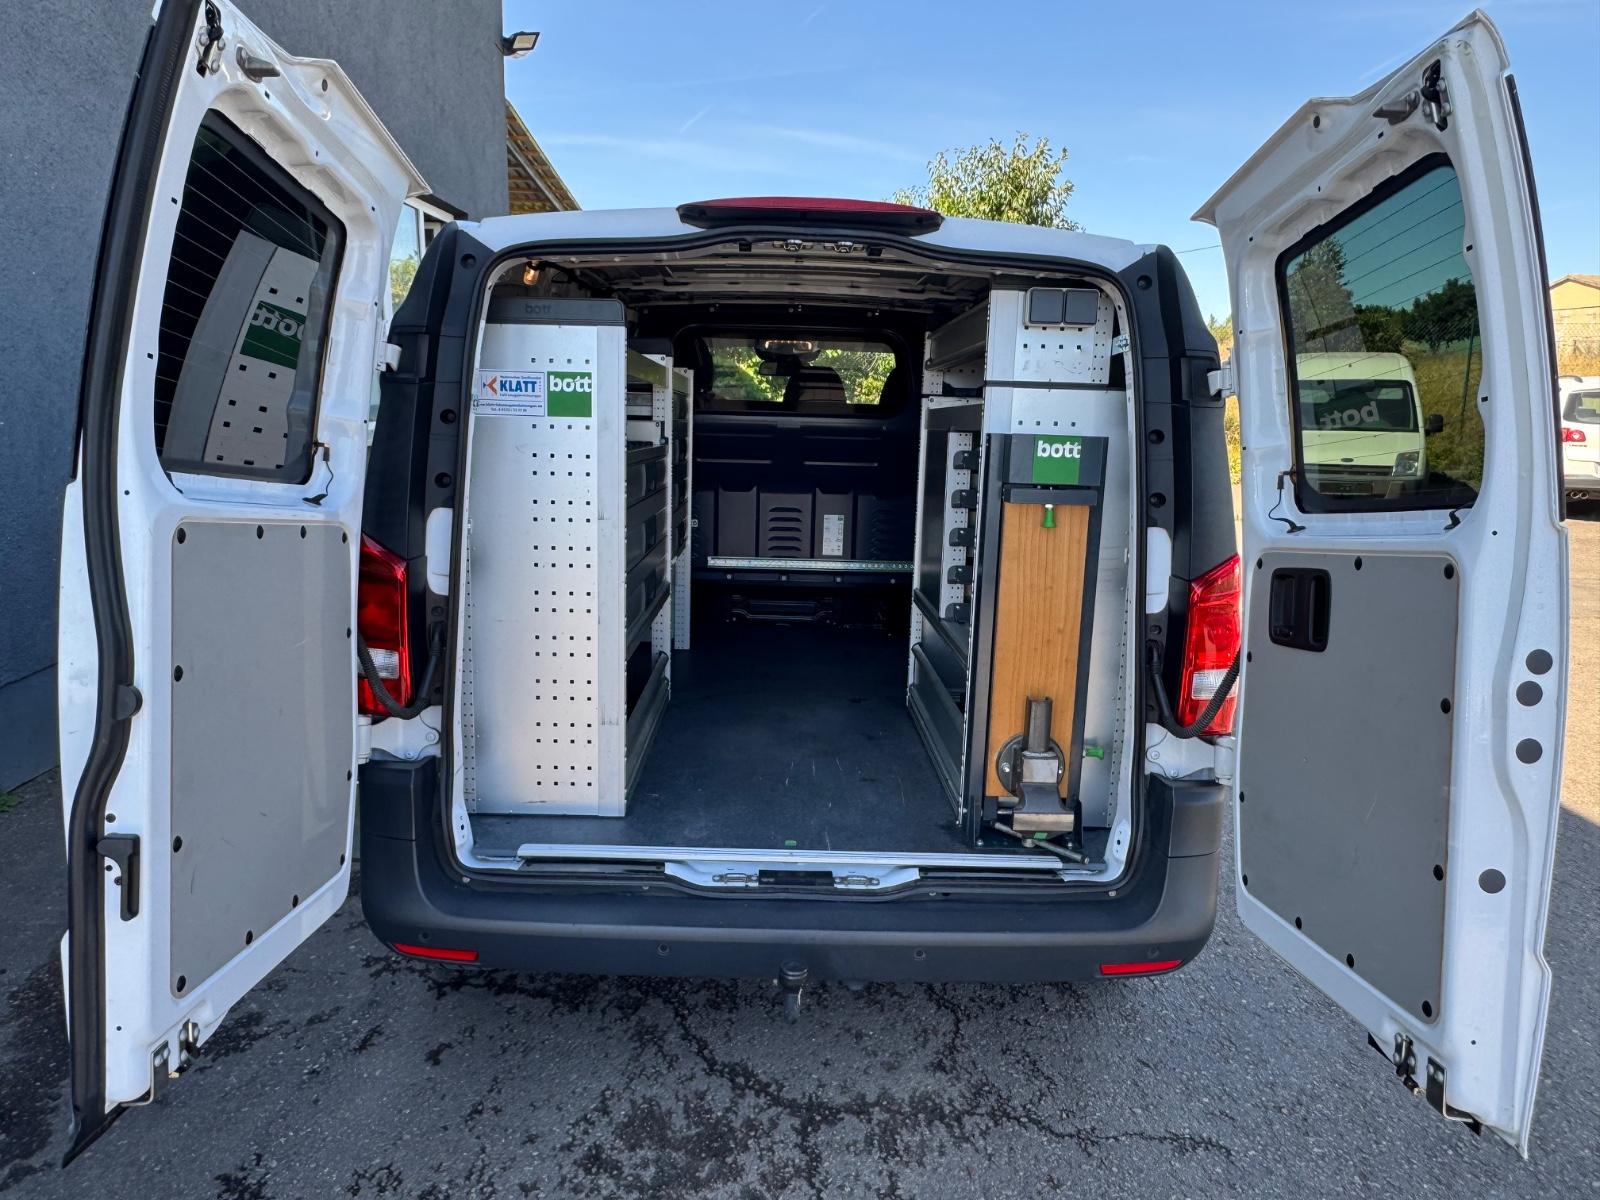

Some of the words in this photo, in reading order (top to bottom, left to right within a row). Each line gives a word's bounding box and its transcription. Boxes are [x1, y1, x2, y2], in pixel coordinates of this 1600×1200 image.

[500, 380, 537, 393] KLATT
[549, 375, 592, 392] bott
[1037, 440, 1081, 459] bott
